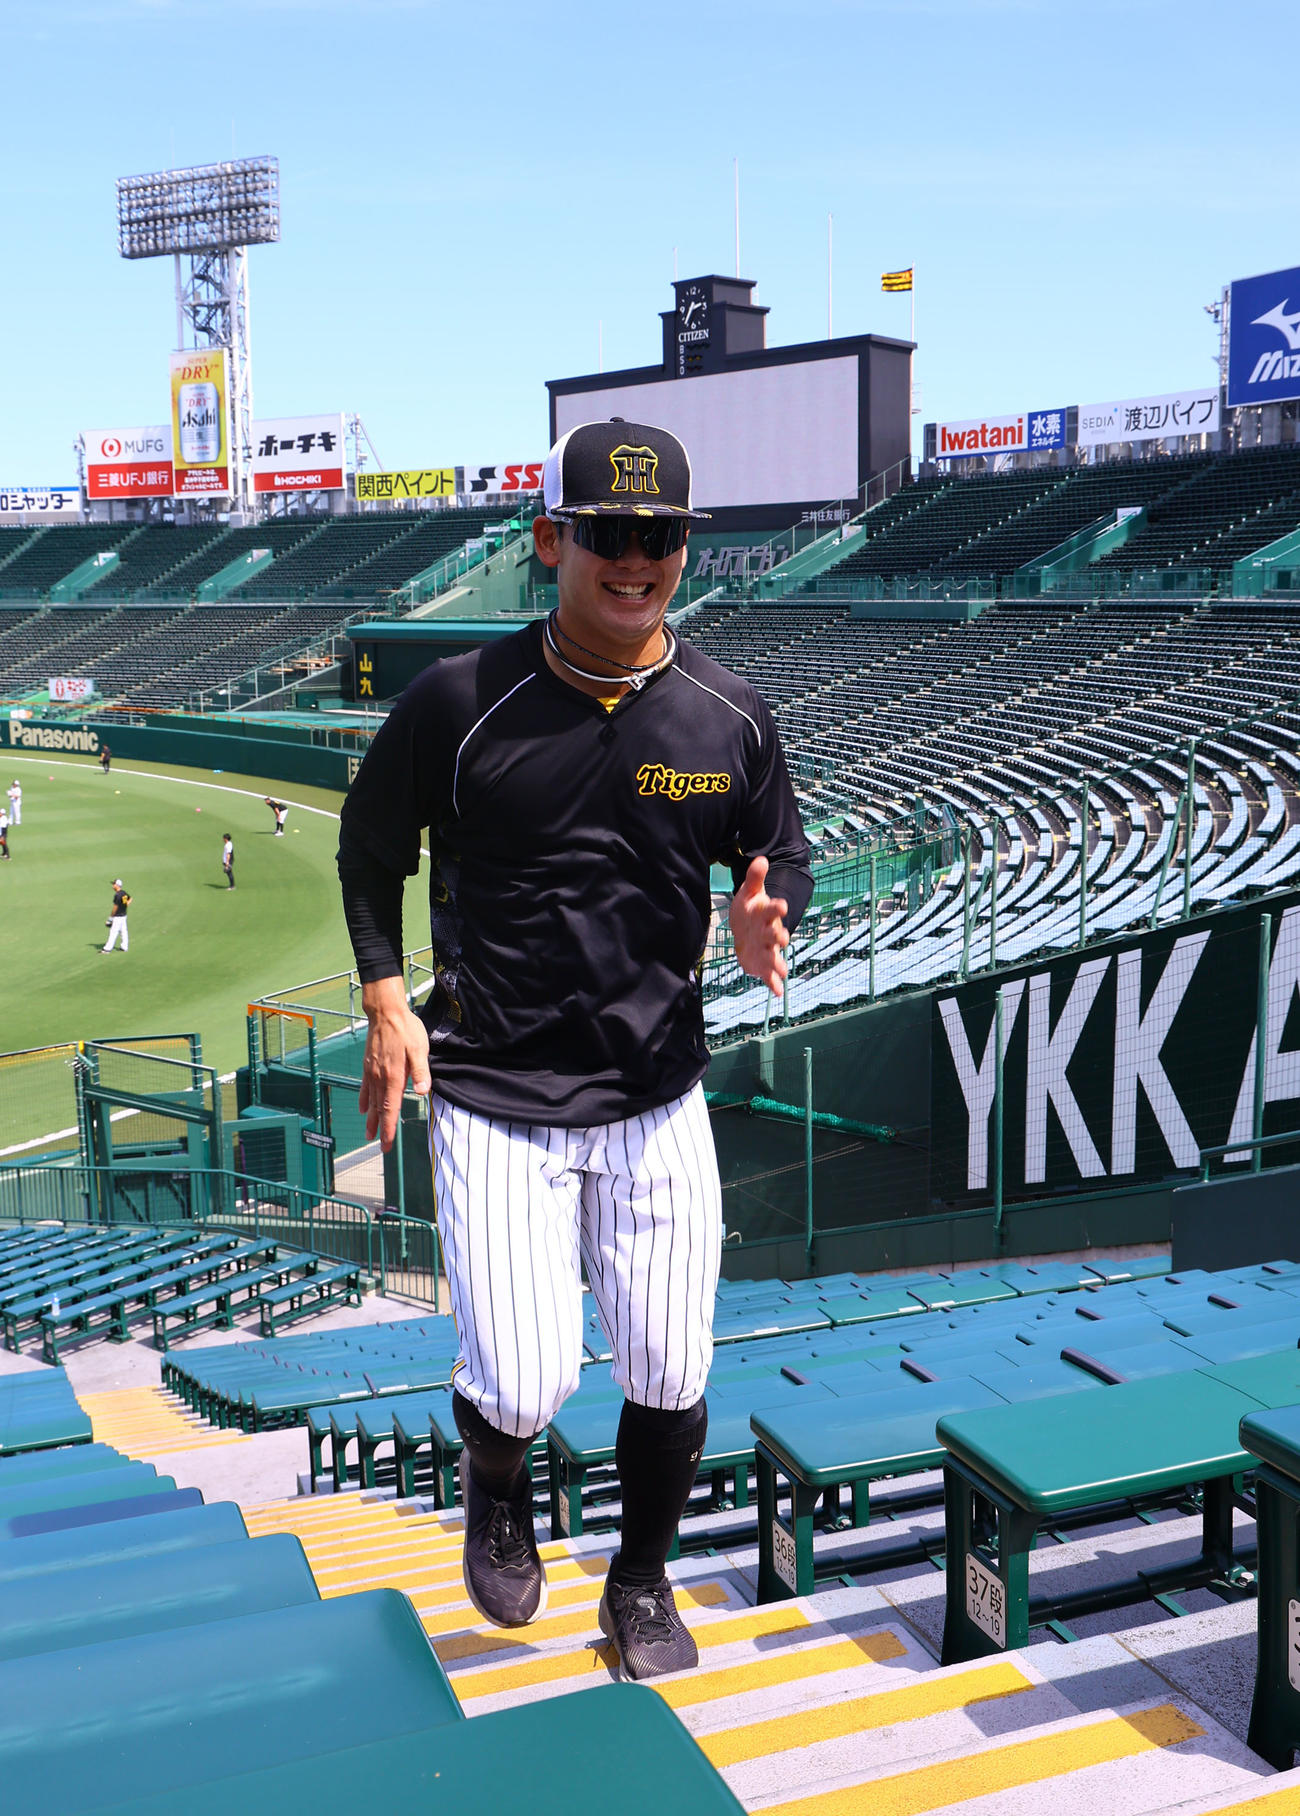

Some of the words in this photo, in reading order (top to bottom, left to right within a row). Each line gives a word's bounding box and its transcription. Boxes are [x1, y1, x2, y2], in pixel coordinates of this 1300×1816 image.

[690, 287, 697, 296] 12
[679, 306, 685, 314] 9
[702, 302, 707, 310] 3
[678, 328, 709, 343] CITIZEN
[690, 322, 696, 330] 6
[679, 345, 684, 355] B
[679, 355, 685, 365] S
[182, 408, 216, 428] Asahi
[1124, 395, 1218, 432] 渡辺パイプ
[1032, 413, 1061, 436] 水素
[258, 431, 336, 456] ホーチキ
[941, 418, 1023, 452] Iwatani
[1031, 436, 1061, 447] エネルギー
[124, 439, 164, 453] MUFG
[98, 471, 168, 487] 三菱UFJ銀行
[281, 475, 321, 485] HOCHIKI
[358, 471, 453, 497] 関西ペイント
[500, 463, 544, 490] SS
[801, 509, 850, 523] 三井住友銀行
[359, 653, 373, 696] 山九
[9, 720, 99, 752] Panasonic
[636, 763, 731, 801] Tigers
[938, 929, 1212, 1190] YKK
[775, 1530, 796, 1570] 36段
[970, 1566, 1002, 1619] 37段
